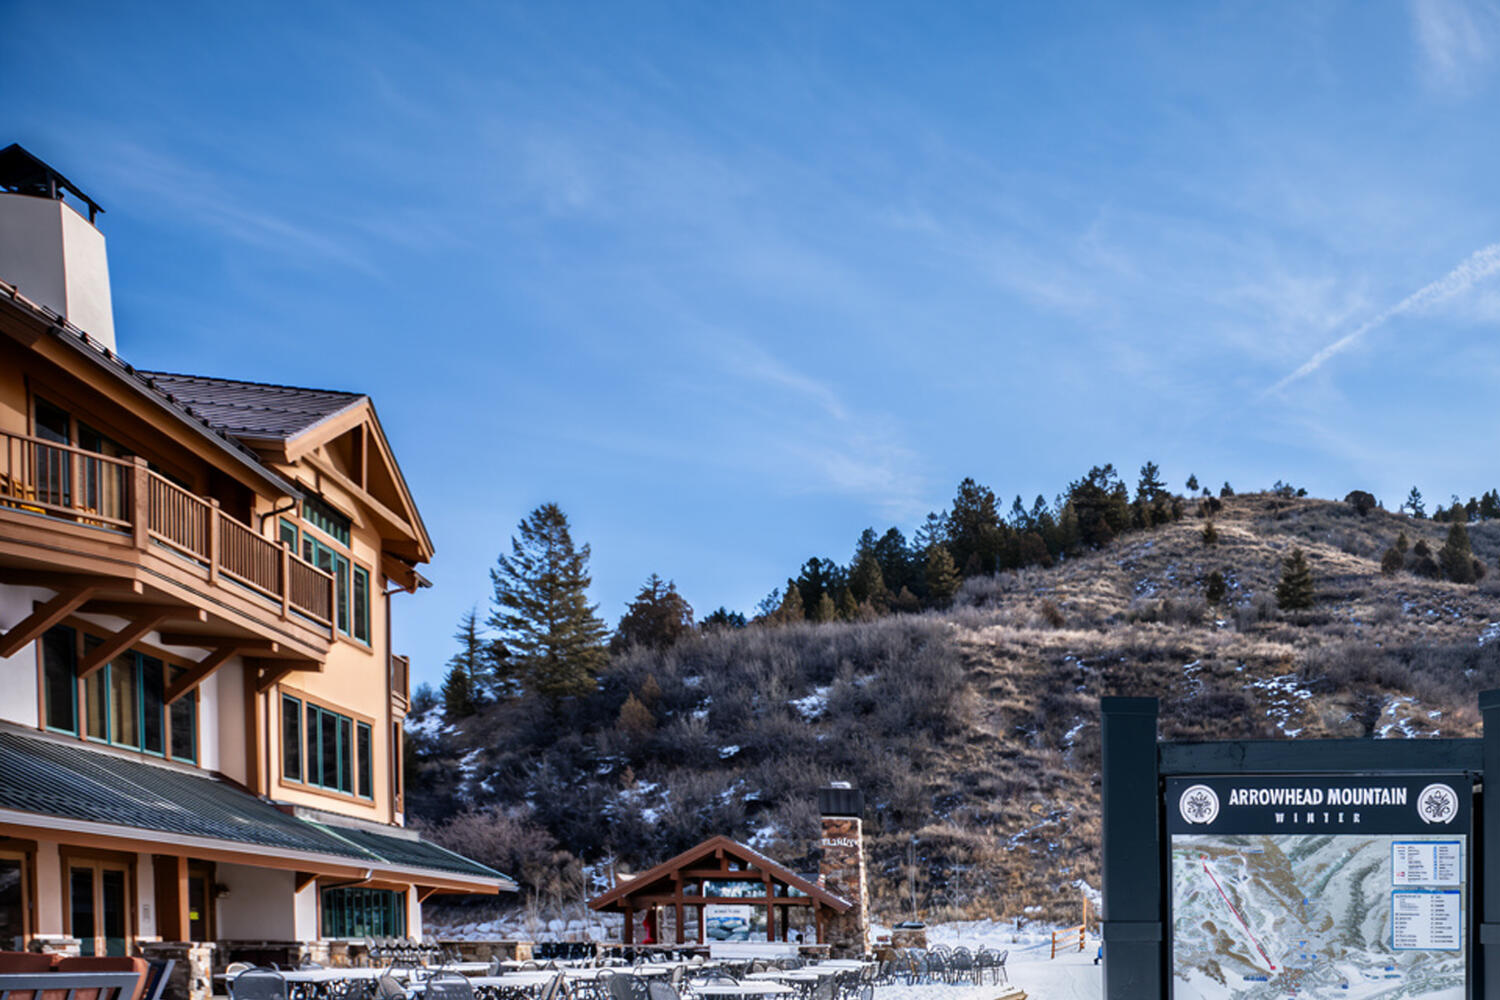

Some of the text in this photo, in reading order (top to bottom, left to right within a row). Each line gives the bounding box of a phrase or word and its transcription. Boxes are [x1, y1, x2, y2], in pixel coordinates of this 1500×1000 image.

[1229, 787, 1408, 806] ARROWHEAD MOUNTAIN
[1275, 812, 1361, 824] WINTER
